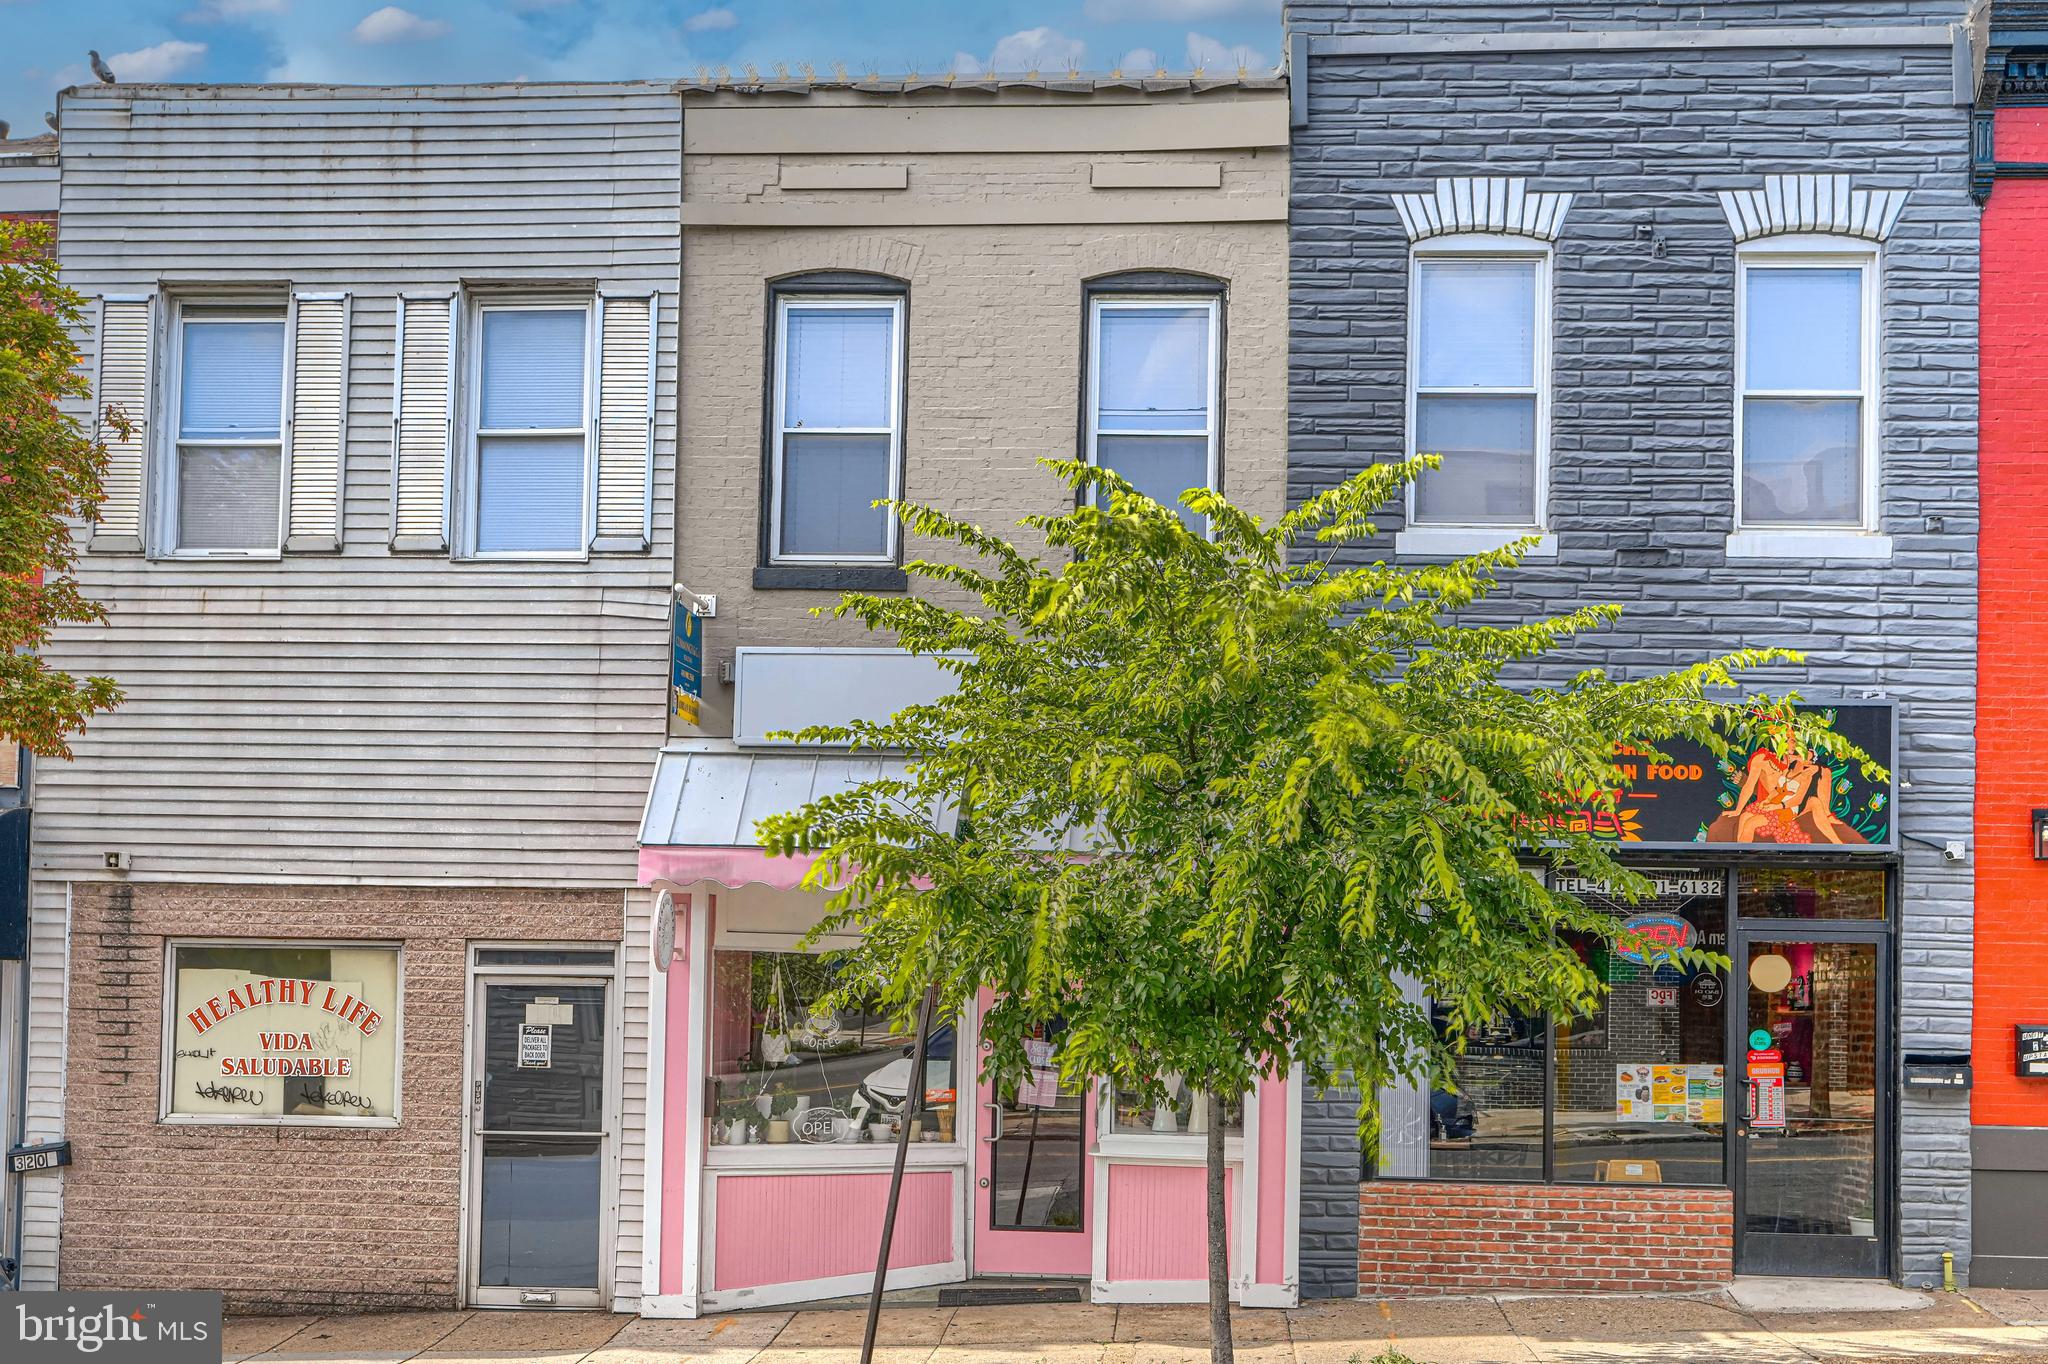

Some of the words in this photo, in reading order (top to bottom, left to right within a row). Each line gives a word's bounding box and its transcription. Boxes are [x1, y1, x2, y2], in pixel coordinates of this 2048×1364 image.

[1647, 764, 1704, 780] FOOD
[186, 978, 316, 1035] HEALTHY
[321, 985, 384, 1037] LIFE
[525, 1026, 547, 1035] Please
[259, 1032, 315, 1051] VIDA
[802, 1035, 841, 1050] COFFEE
[220, 1058, 352, 1077] SALUDABLE
[802, 1121, 842, 1135] OPEN
[16, 1154, 46, 1170] 320
